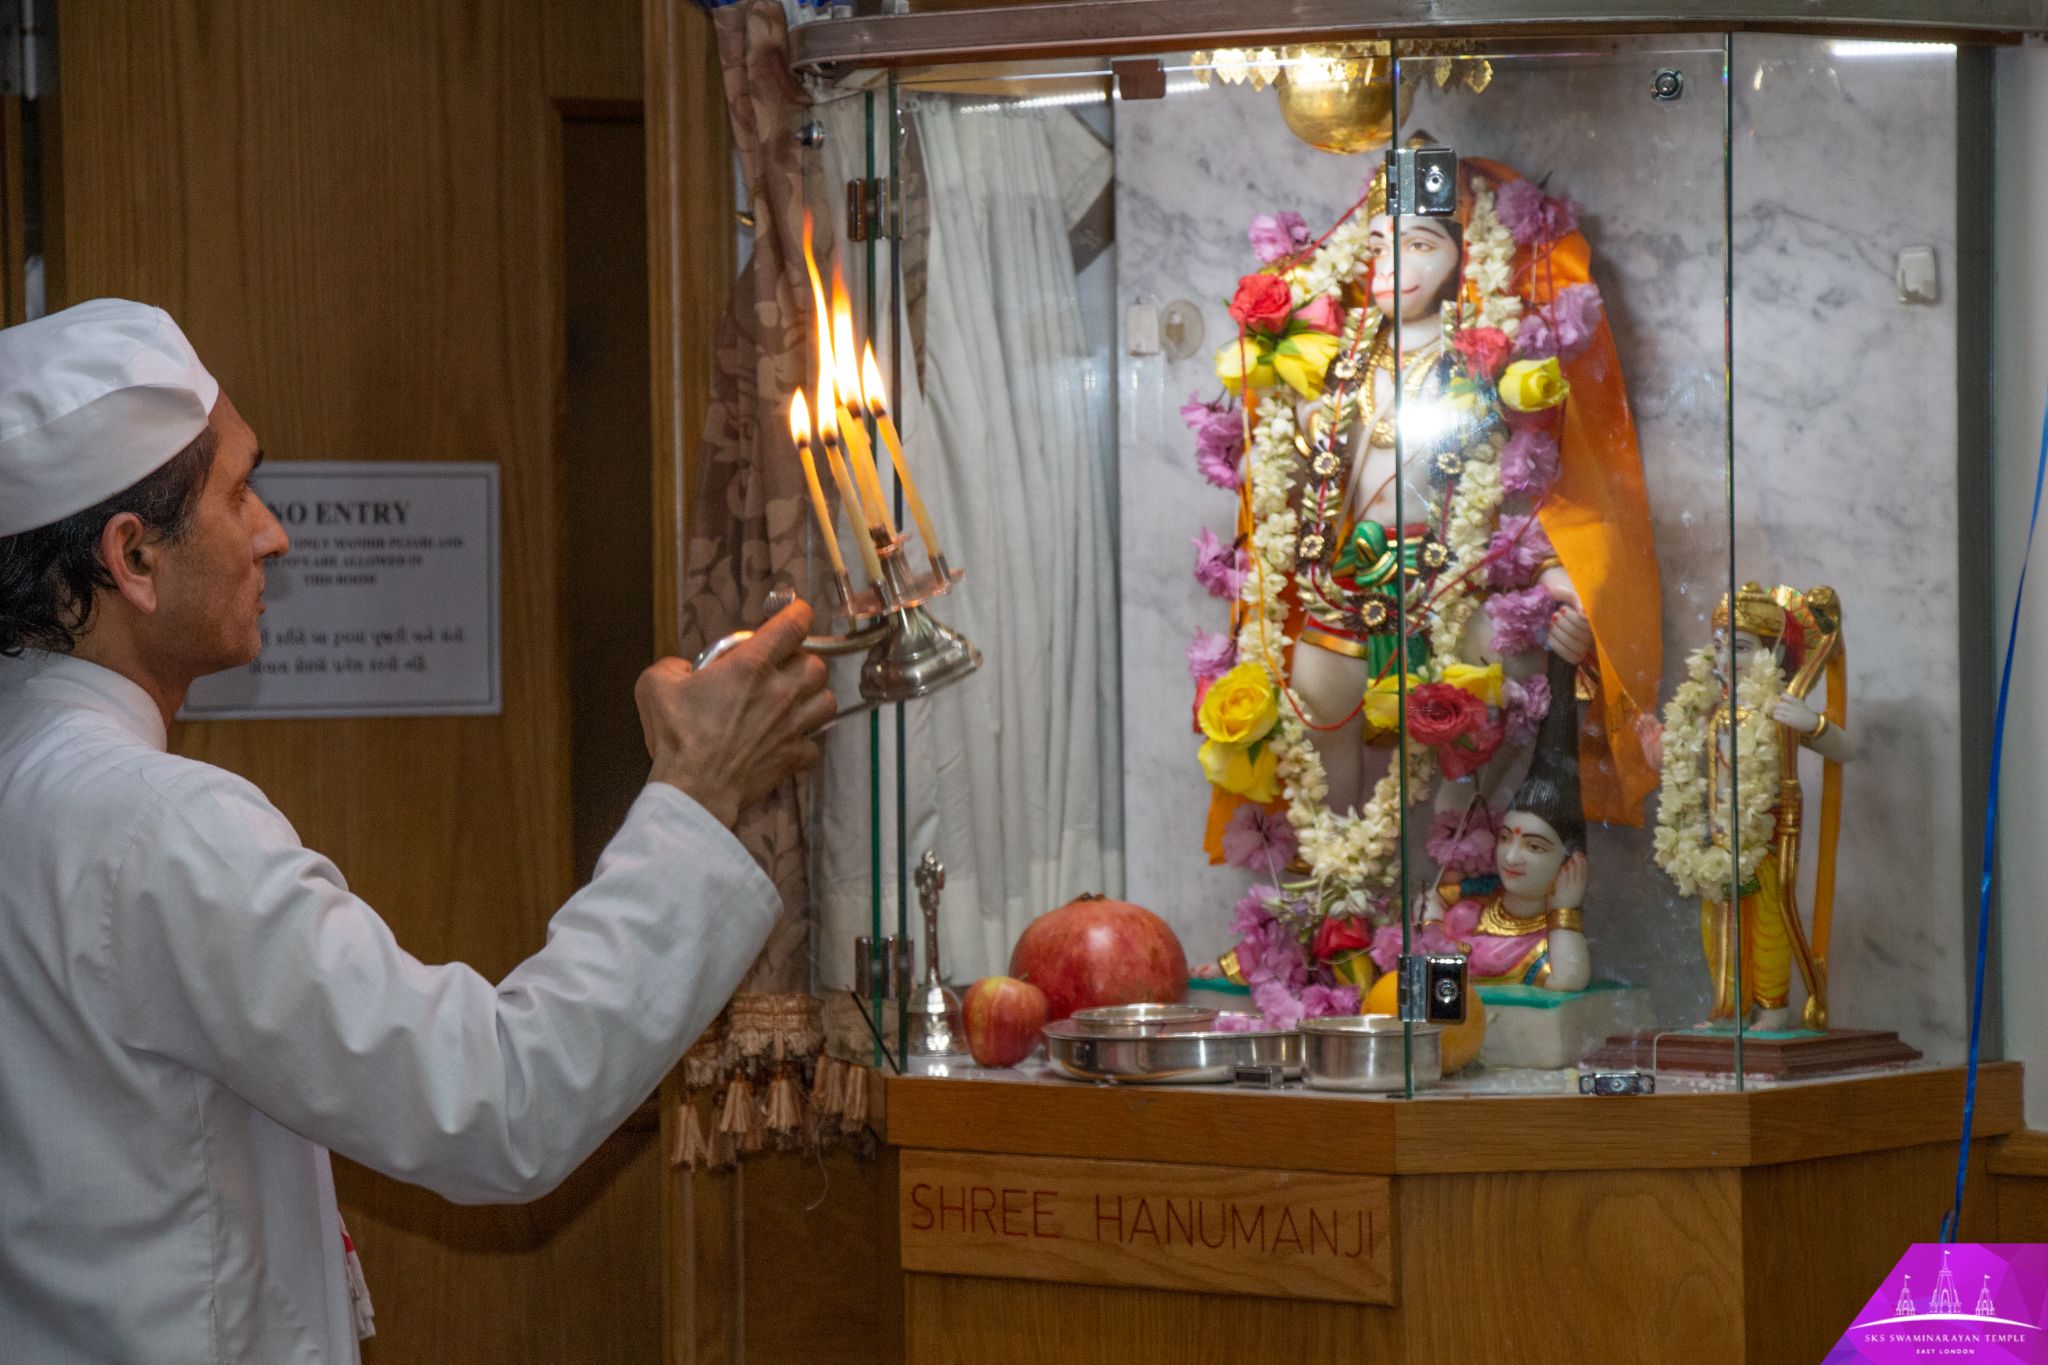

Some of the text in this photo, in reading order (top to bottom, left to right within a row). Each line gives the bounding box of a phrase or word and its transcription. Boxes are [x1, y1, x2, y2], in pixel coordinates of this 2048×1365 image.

[315, 502, 411, 525] ENTRY
[911, 1183, 1375, 1260] SHREE HANUMANJI
